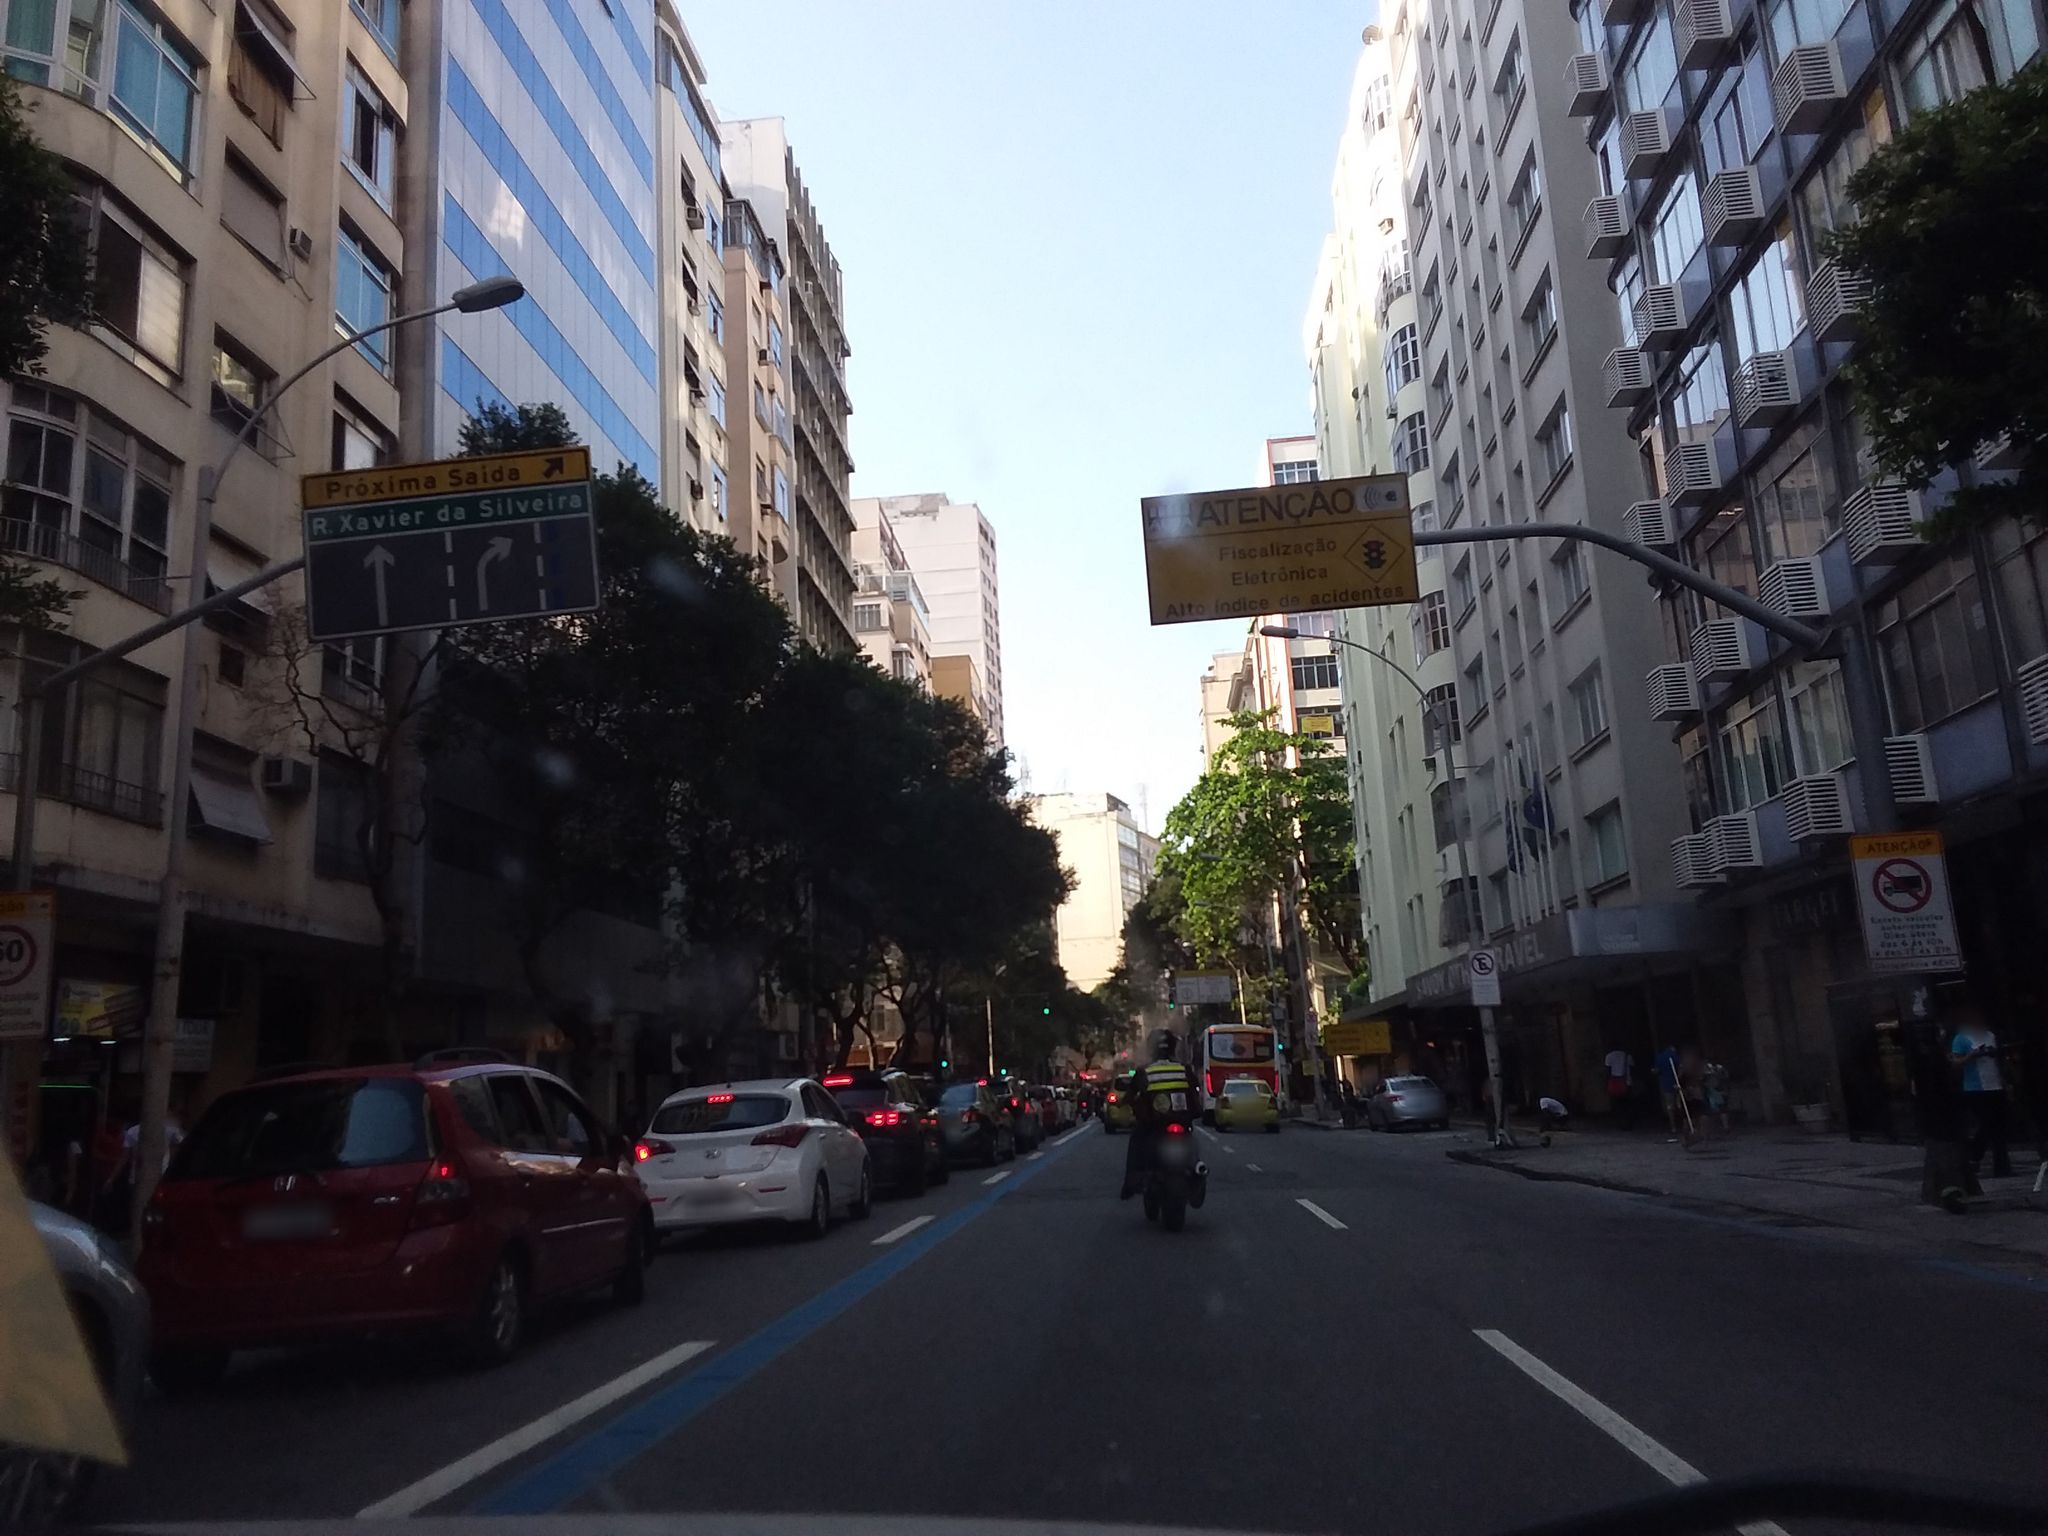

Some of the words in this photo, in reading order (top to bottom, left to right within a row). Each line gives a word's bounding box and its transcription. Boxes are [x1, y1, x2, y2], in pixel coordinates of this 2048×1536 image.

[325, 476, 438, 500] Próxima
[312, 516, 333, 536] R.
[339, 508, 425, 533] Xavier
[436, 504, 467, 523] da
[479, 491, 583, 518] Silveira
[1196, 486, 1356, 528] ATENÇÃO
[1219, 537, 1338, 561] Fiscalização
[1231, 564, 1329, 587] Eletrônica
[1165, 601, 1206, 620] Alto
[1278, 593, 1299, 610] de
[1310, 584, 1405, 605] acidentes
[1495, 932, 1545, 972] RAVEL
